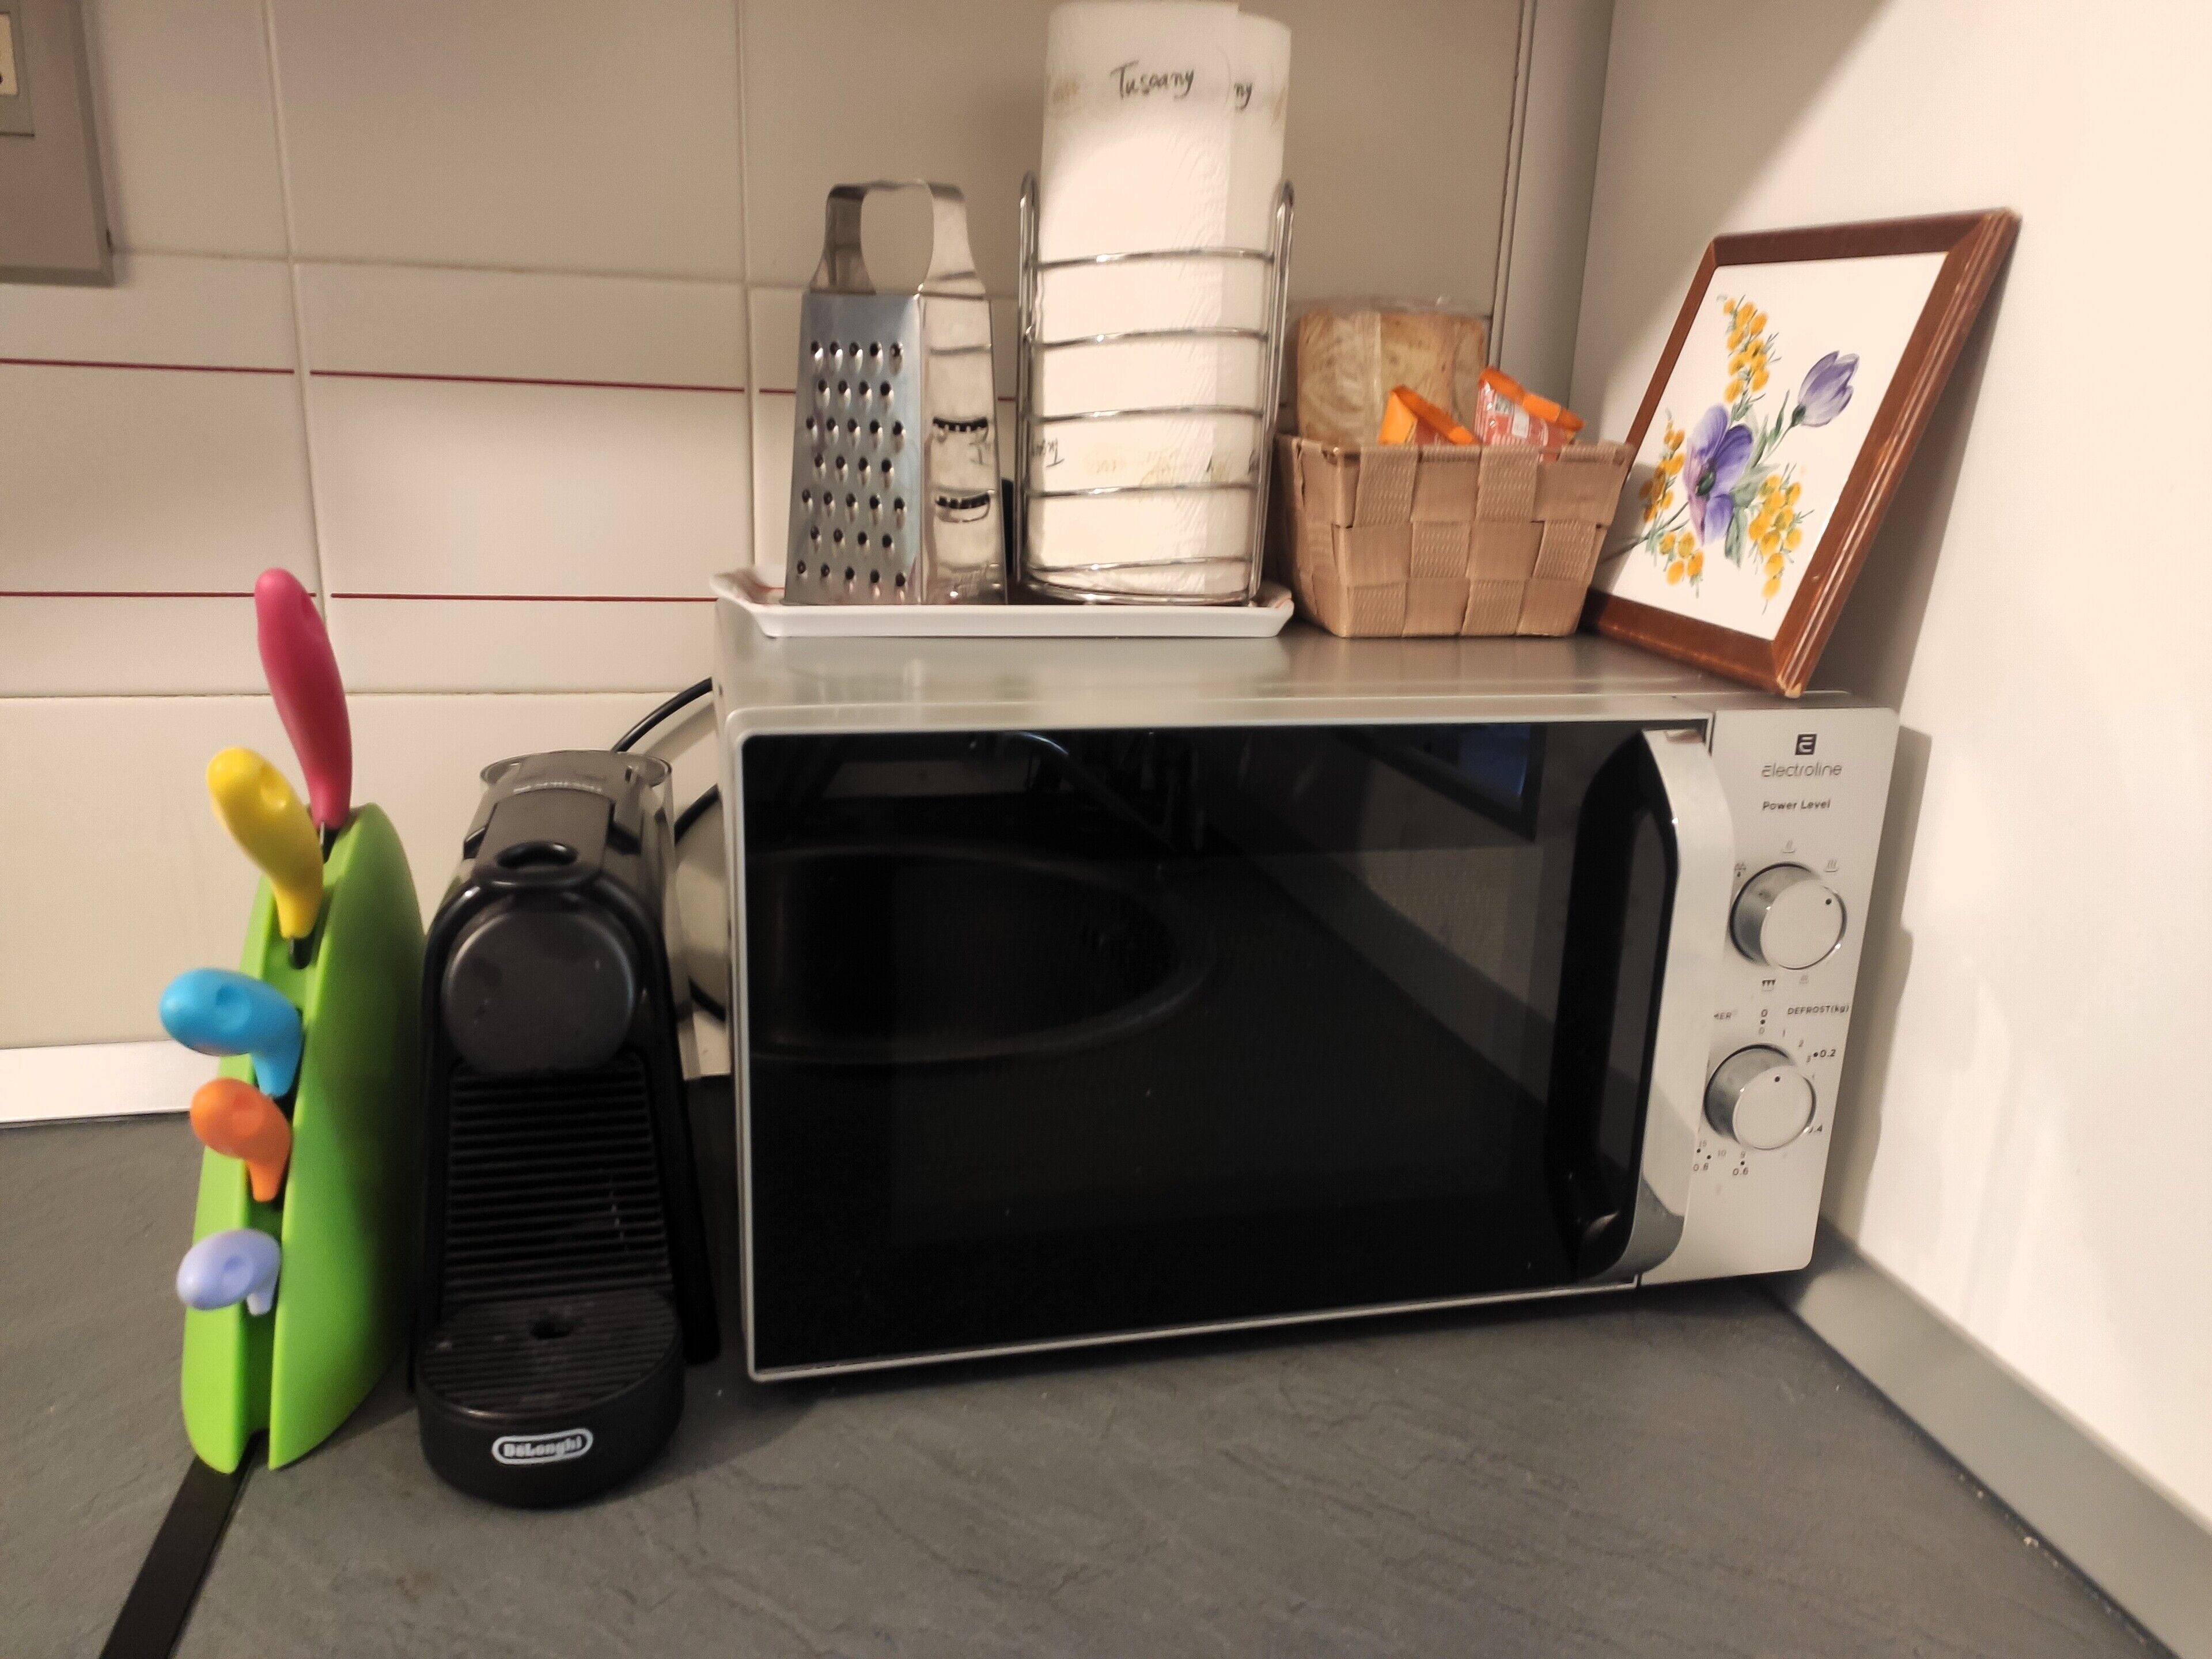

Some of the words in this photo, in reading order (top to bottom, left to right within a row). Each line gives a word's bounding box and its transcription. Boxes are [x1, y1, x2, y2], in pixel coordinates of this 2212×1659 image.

[1762, 762, 1843, 777] Electroline
[1762, 800, 1798, 811] Power
[1800, 798, 1831, 810] Level
[1820, 1048, 1836, 1058] 0.2
